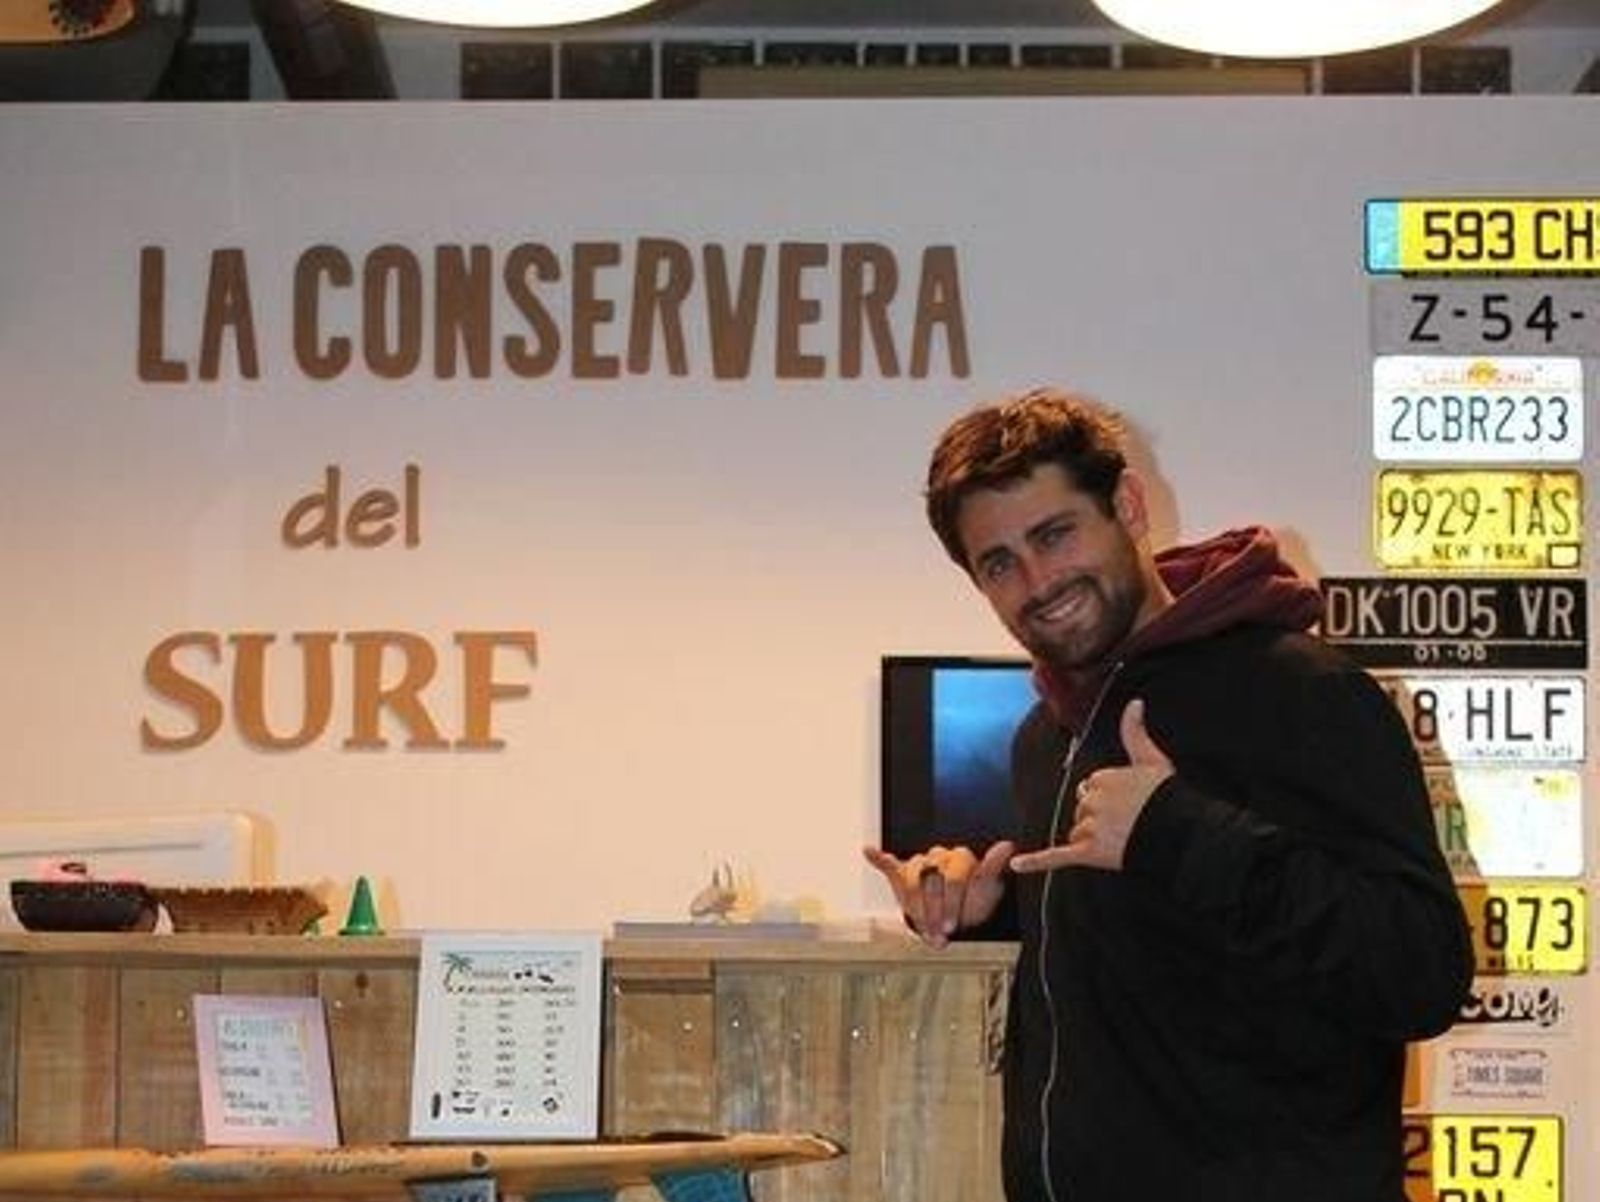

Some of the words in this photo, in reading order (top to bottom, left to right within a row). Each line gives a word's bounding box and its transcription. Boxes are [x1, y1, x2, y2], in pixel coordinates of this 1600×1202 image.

[1423, 209, 1515, 261] 593
[1534, 208, 1600, 261] CH
[137, 245, 260, 382] LA
[292, 237, 972, 381] CONSERVERA
[1390, 396, 1569, 442] 2CBR233
[281, 464, 421, 549] del
[1387, 487, 1572, 536] 9929-TAS
[1432, 543, 1470, 560] NEW
[1482, 543, 1528, 560] YORK
[1327, 585, 1385, 637] DK
[1393, 584, 1497, 638] 1005
[1519, 586, 1575, 637] VR
[139, 630, 539, 753] SURF
[1484, 896, 1574, 951] 873
